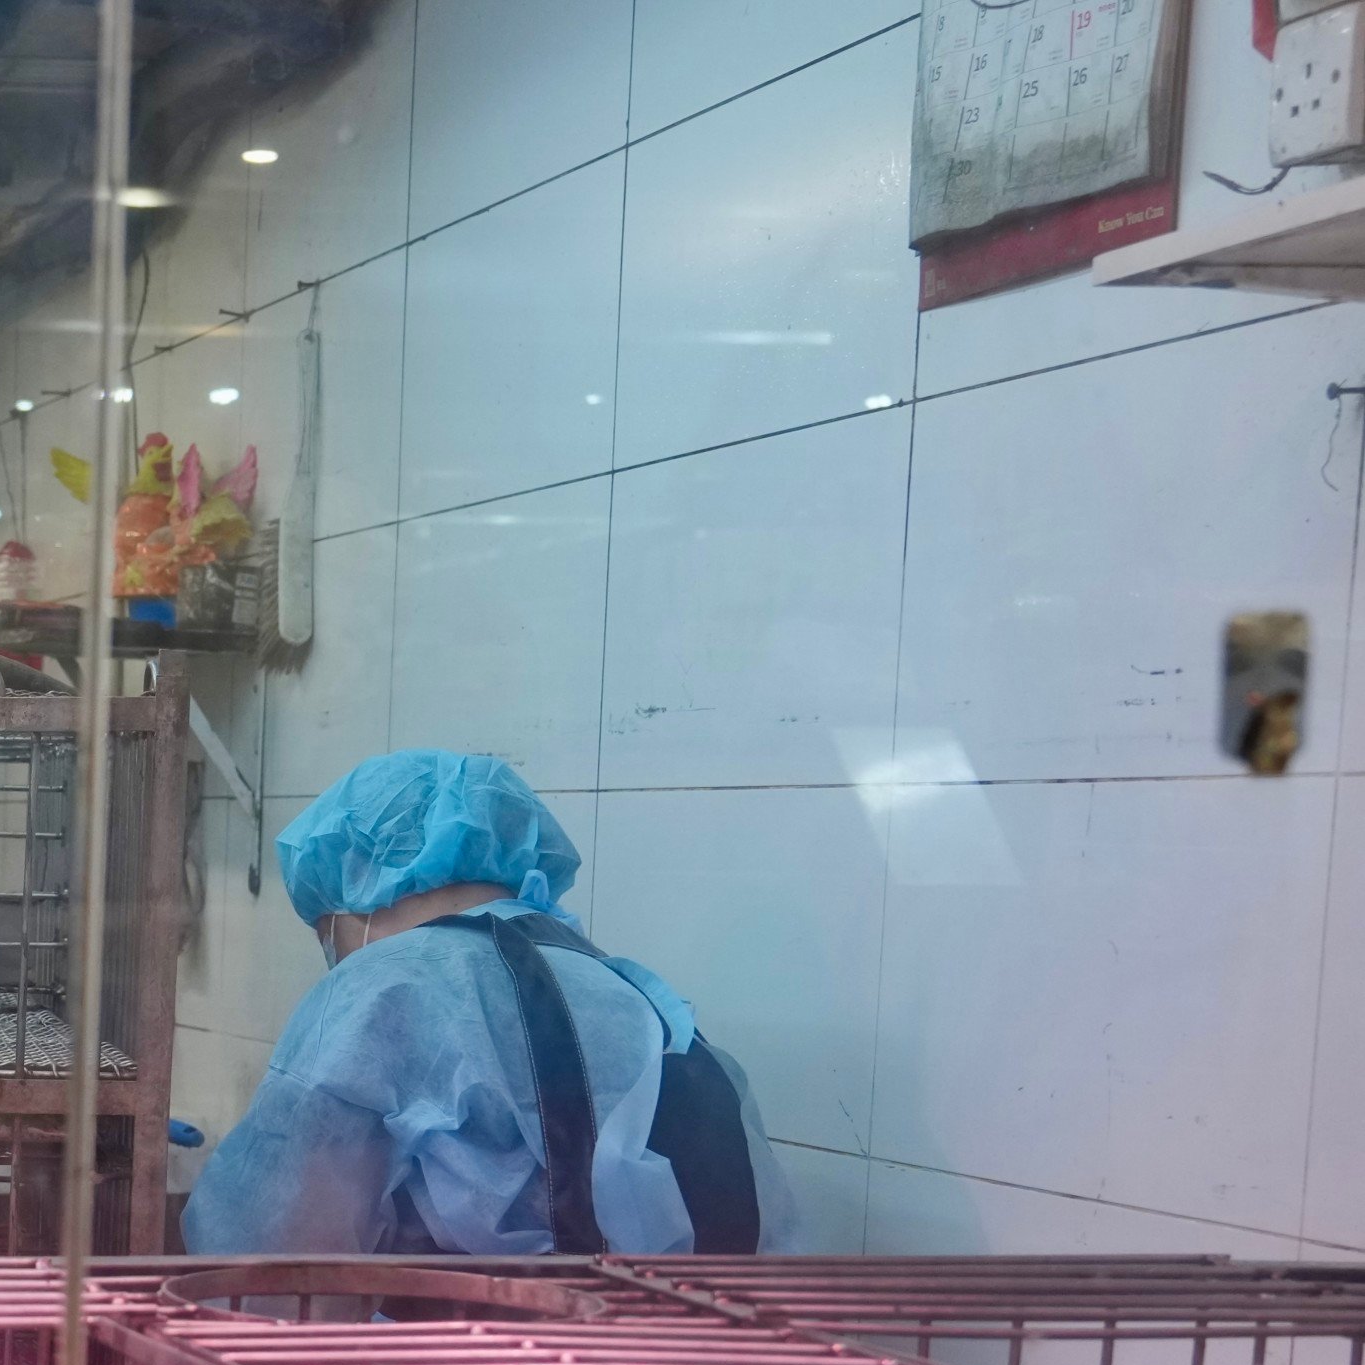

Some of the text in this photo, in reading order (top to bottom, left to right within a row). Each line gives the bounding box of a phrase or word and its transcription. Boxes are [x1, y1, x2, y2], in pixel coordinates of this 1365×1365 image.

[930, 66, 942, 83] 15
[973, 54, 988, 72] 16
[1032, 25, 1044, 43] 18
[1076, 12, 1092, 30] 19
[963, 54, 1130, 125] 23 25 26 27
